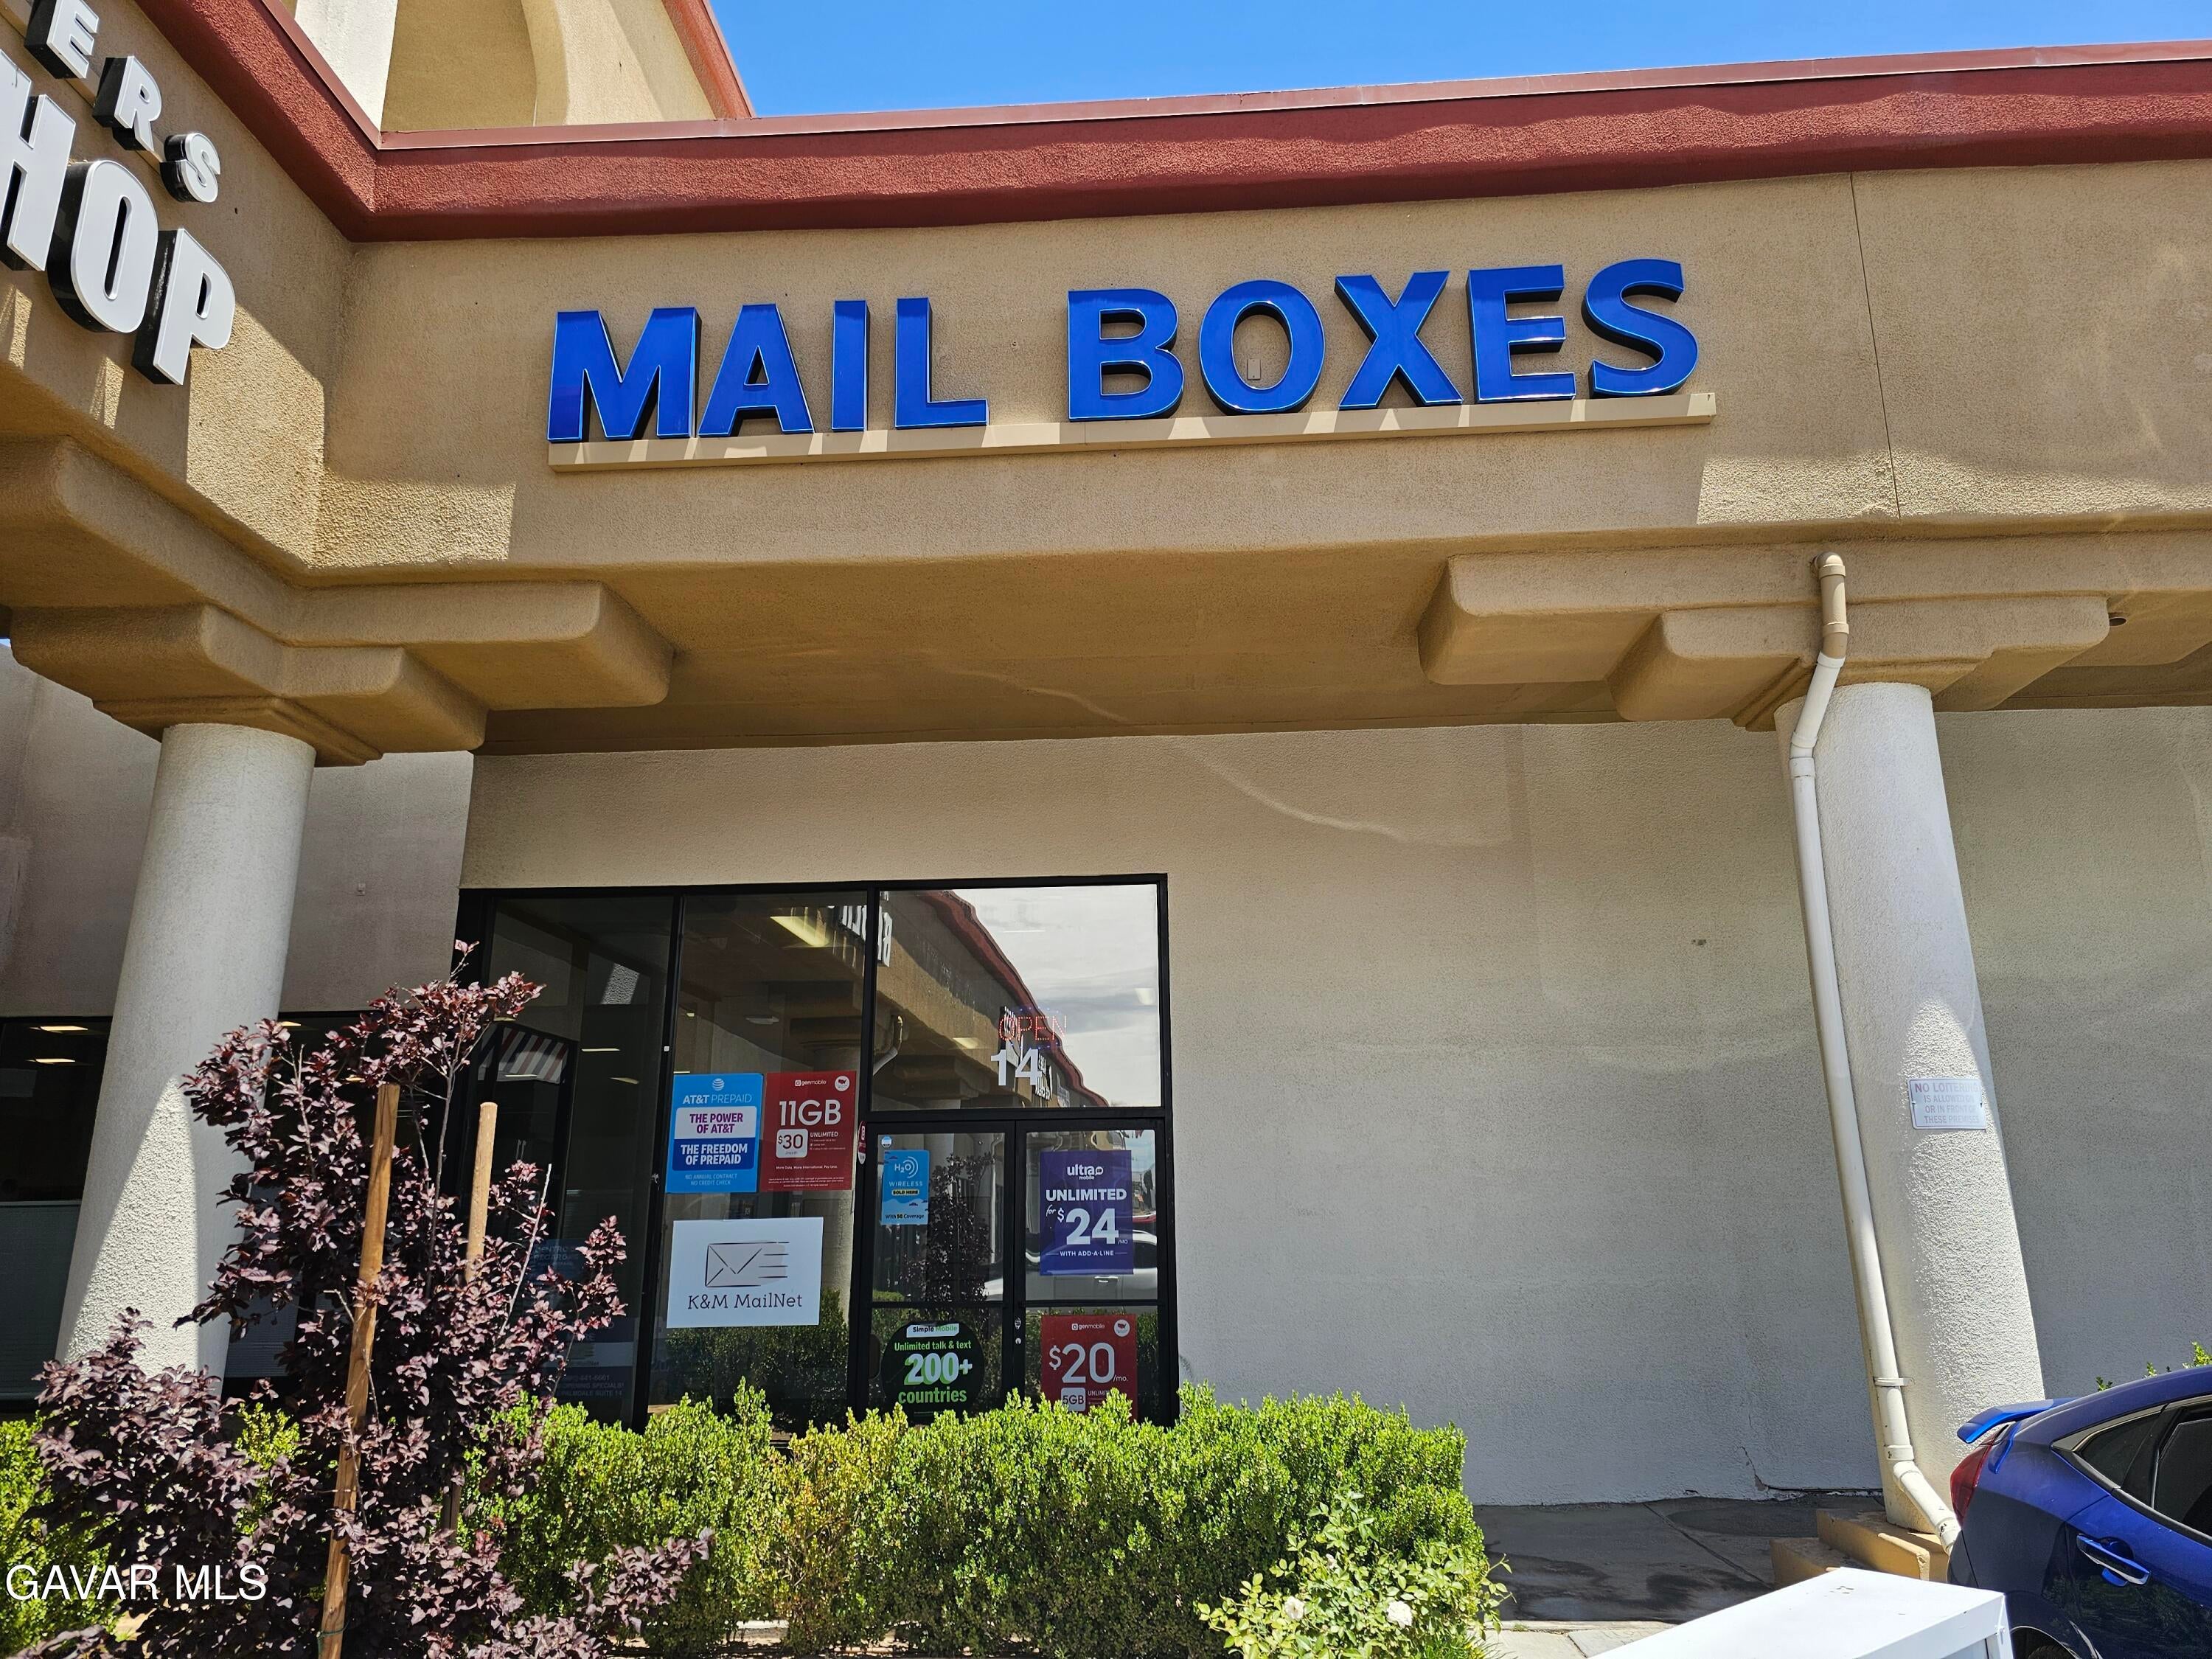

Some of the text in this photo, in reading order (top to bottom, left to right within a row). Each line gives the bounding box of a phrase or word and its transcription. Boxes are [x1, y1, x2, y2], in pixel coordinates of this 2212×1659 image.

[547, 259, 1698, 442] MAIL BOXES
[998, 1015, 1067, 1040] OPEN
[991, 1048, 1042, 1085] 14
[1915, 1083, 1929, 1093] NO
[683, 1093, 752, 1104] AT&T PREPAID
[1924, 1095, 1931, 1103] IS
[779, 1099, 841, 1126] 11GB
[1925, 1105, 1935, 1113] OR
[1938, 1105, 1944, 1113] IN
[689, 1113, 743, 1123] THE POWER
[697, 1124, 735, 1133] OF AT&T
[778, 1134, 803, 1149] $30
[681, 1144, 748, 1155] THE FREEDOM
[686, 1155, 741, 1165] OF PREPAID
[1067, 1164, 1096, 1176] ultra
[1046, 1189, 1127, 1201] UNLIMITED
[1046, 1205, 1056, 1217] for
[688, 1293, 802, 1310] K&M MailNet
[894, 1340, 972, 1351] Unlimited talk & text
[904, 1352, 973, 1385] 200+
[898, 1386, 967, 1404] countries
[1062, 1395, 1085, 1405] 5GB
